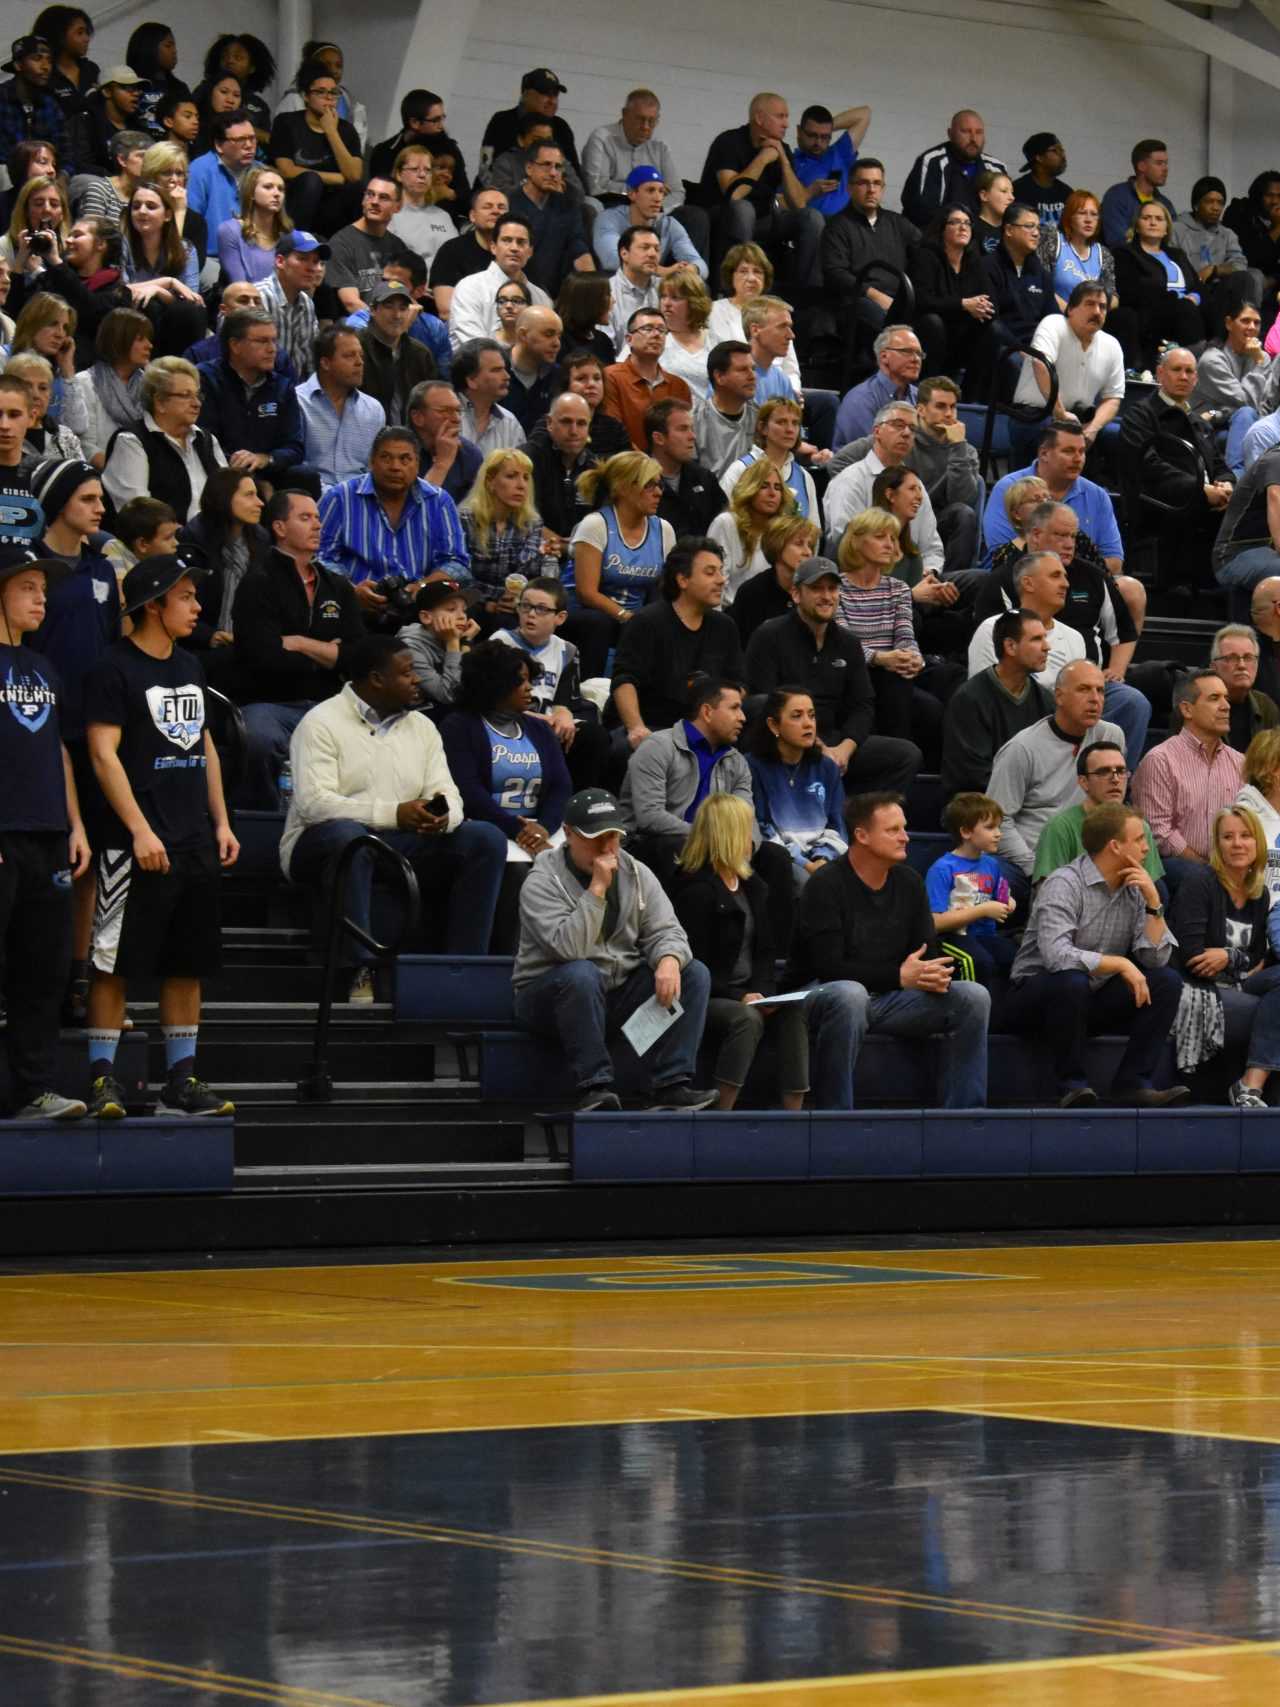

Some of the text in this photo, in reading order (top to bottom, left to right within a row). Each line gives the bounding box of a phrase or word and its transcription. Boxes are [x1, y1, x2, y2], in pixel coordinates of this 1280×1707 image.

[3, 487, 35, 498] CIRCL
[0, 689, 56, 705] KNIGHTS
[22, 704, 39, 716] P
[163, 693, 197, 723] ETW
[491, 744, 541, 770] Prosp
